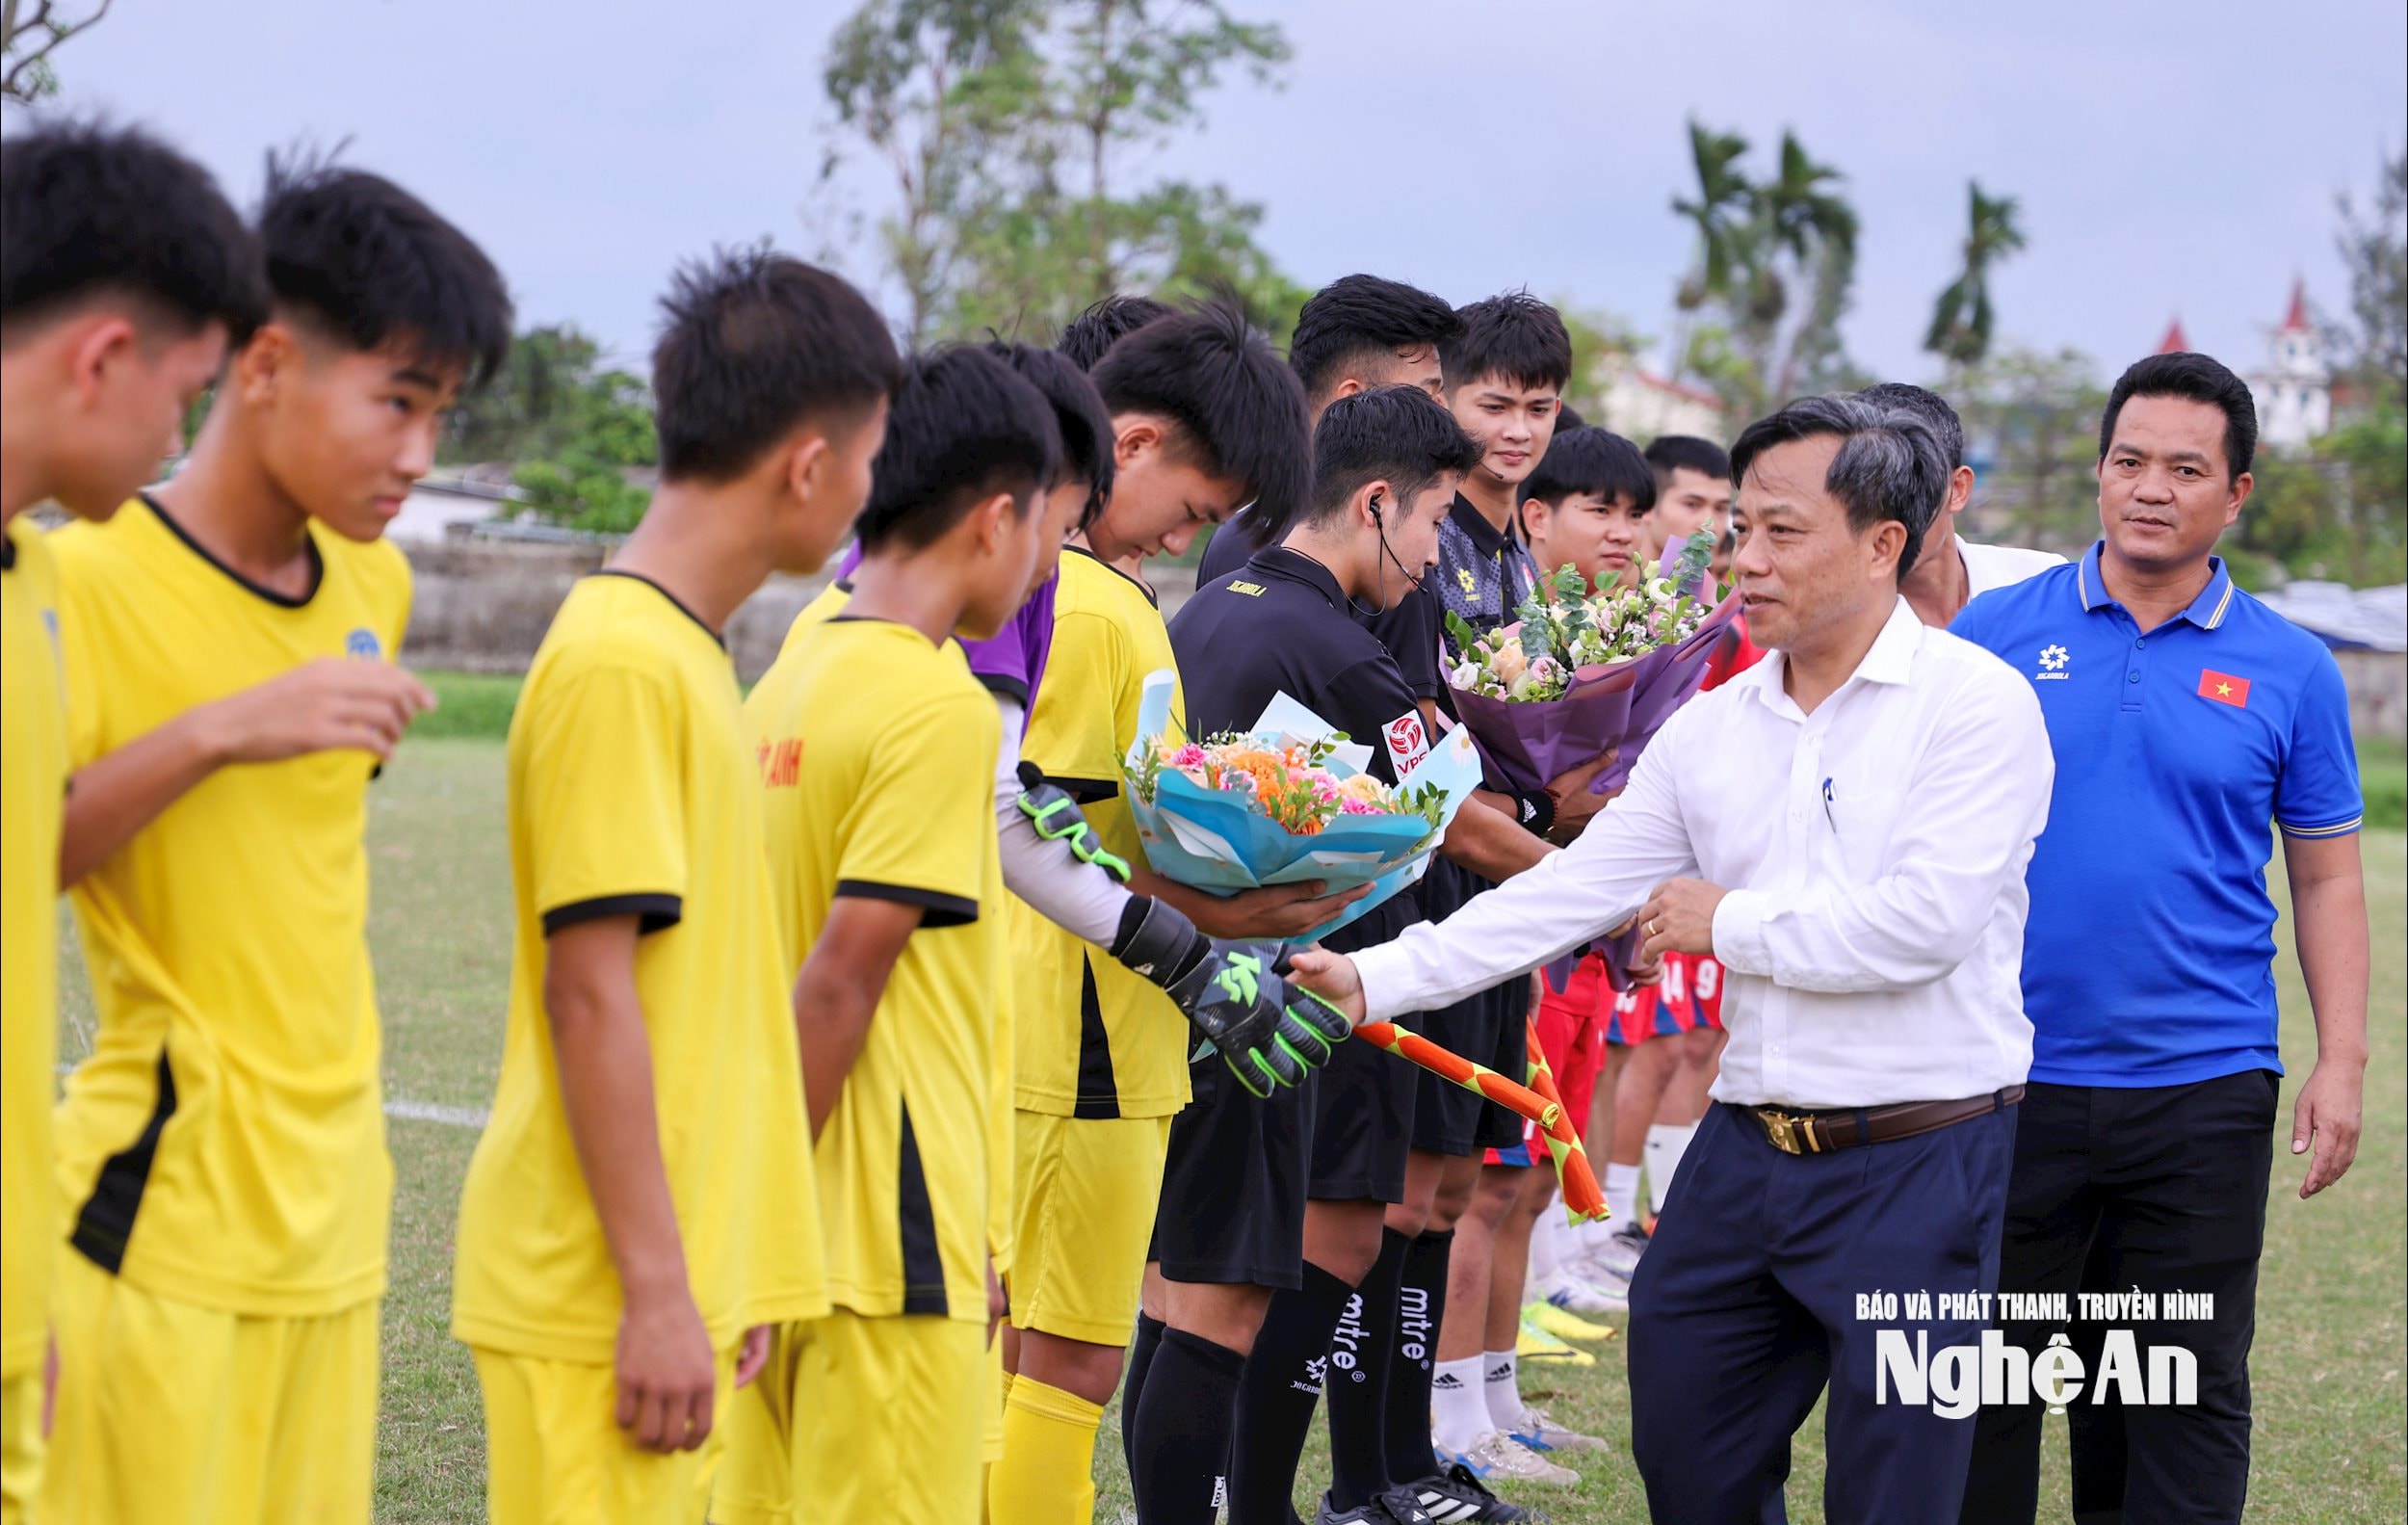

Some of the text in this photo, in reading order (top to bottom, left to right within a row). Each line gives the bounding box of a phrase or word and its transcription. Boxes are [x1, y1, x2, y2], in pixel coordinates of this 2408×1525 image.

[1695, 959, 1718, 1000] 9
[1331, 1292, 1371, 1370] mitre
[1400, 1286, 1432, 1360] mitre
